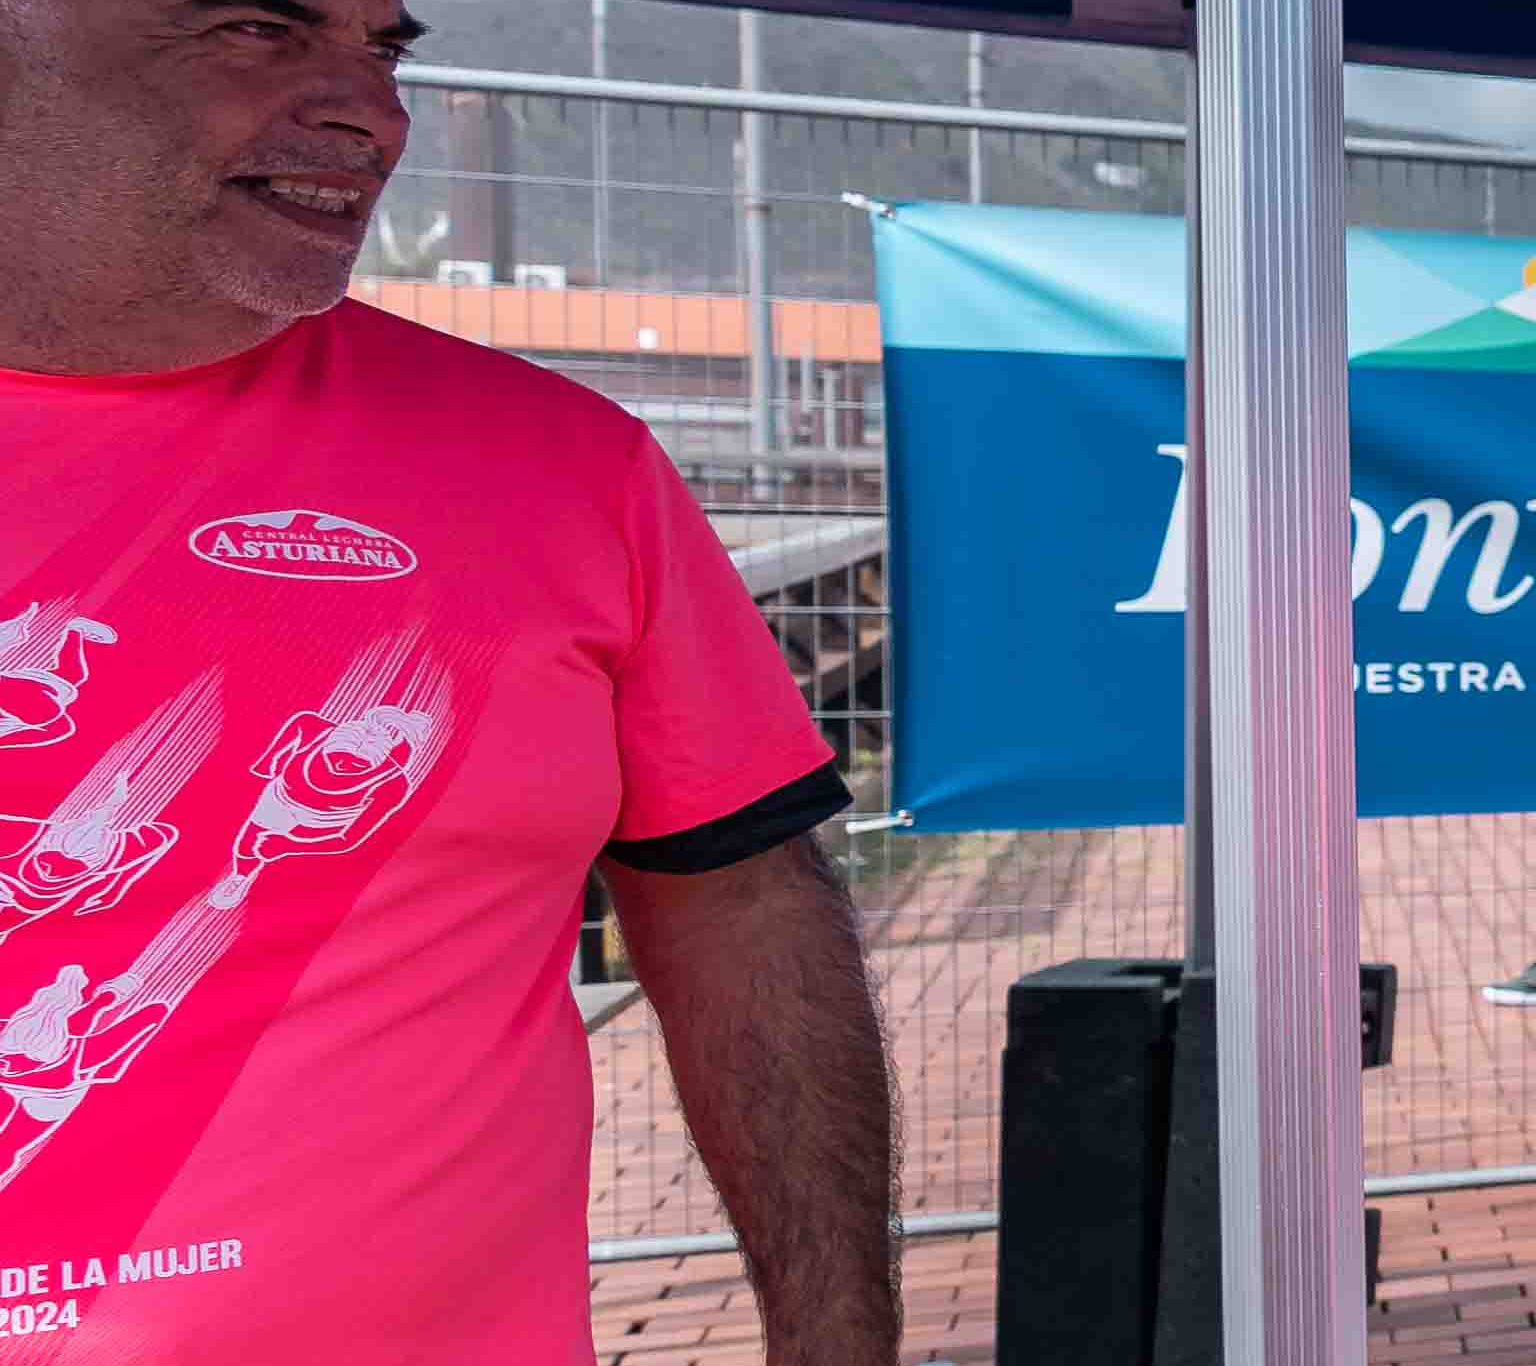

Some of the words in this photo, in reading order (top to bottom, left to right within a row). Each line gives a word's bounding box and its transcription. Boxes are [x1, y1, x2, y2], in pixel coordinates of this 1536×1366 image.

[207, 531, 403, 569] ASTURIANA
[241, 530, 318, 541] CENTRAL
[323, 535, 393, 548] LECHERA
[1353, 661, 1526, 694] ESTRA
[0, 1263, 49, 1299] DE
[61, 1258, 107, 1291] LA
[118, 1238, 243, 1284] MUJER
